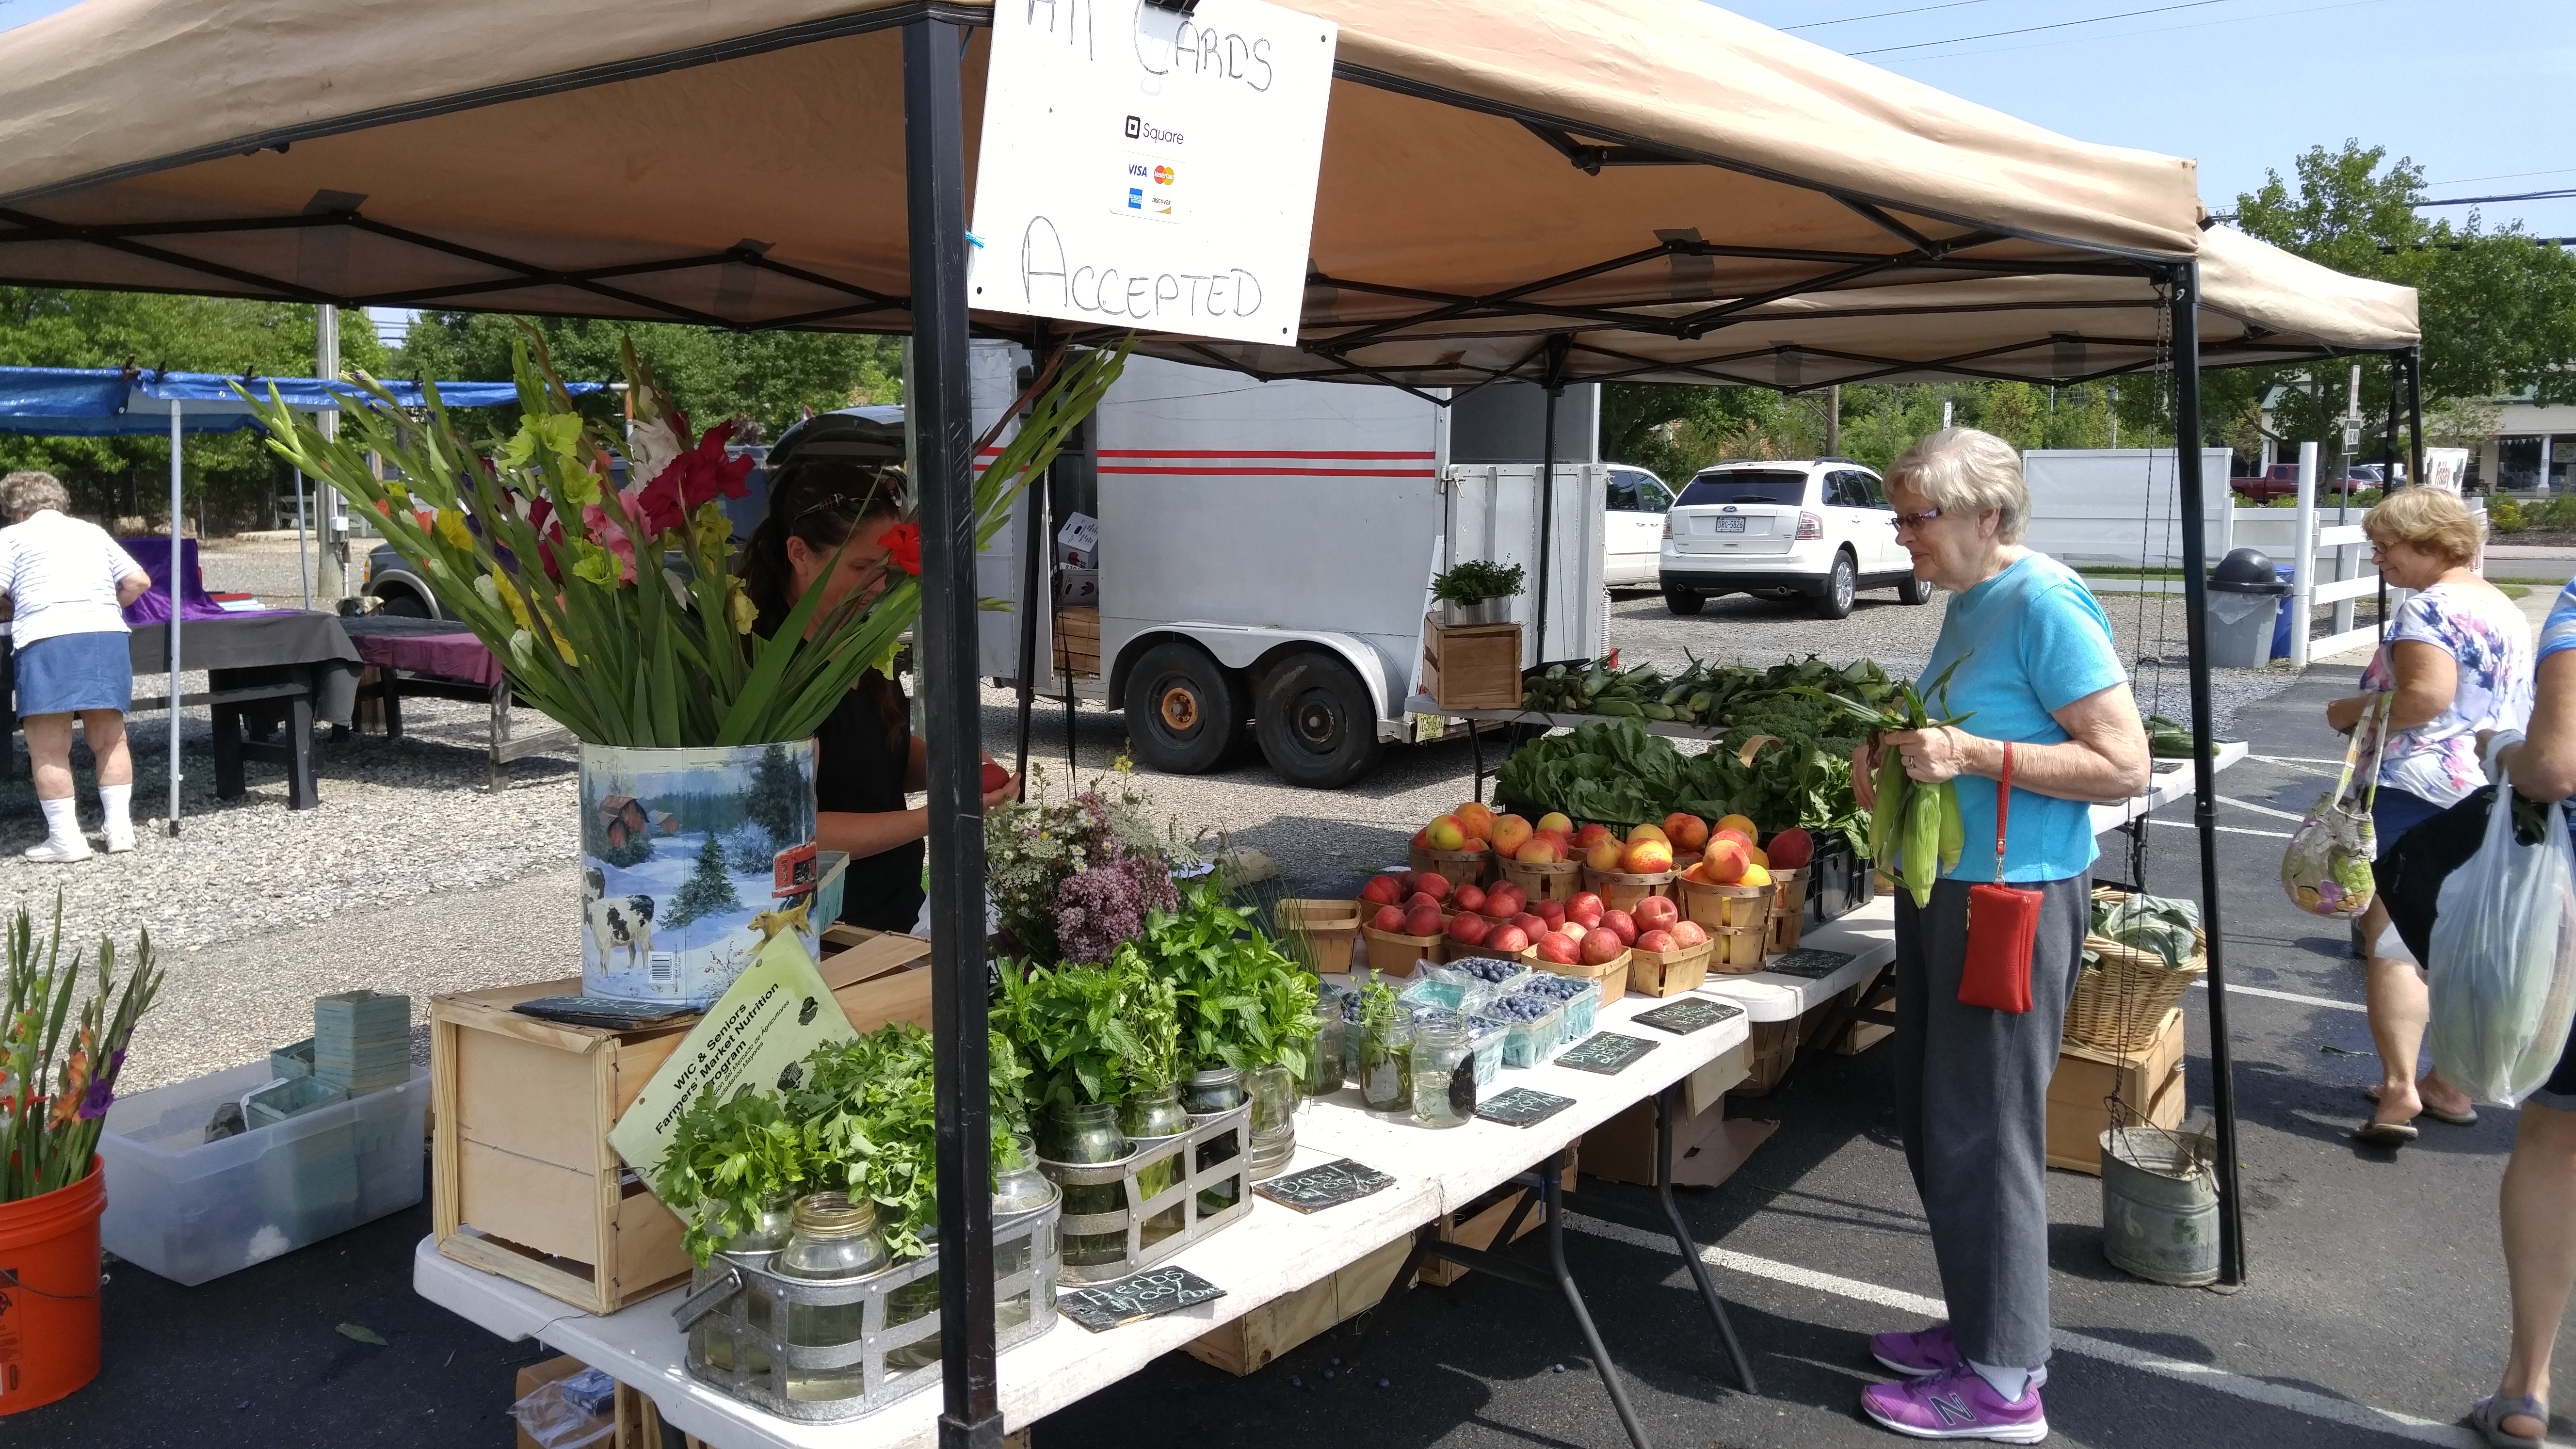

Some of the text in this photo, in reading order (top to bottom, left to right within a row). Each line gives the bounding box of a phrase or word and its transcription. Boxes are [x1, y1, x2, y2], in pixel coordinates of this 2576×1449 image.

[1143, 123, 1184, 145] Square
[1128, 163, 1147, 177] VISA
[1022, 215, 1262, 319] ACCEPTED
[2434, 461, 2451, 489] Friday
[1642, 1004, 1686, 1019] White
[700, 1035, 736, 1079] Market
[735, 983, 779, 1035] Nutrition
[673, 1003, 747, 1090] WIC & Seniors
[724, 1070, 733, 1081] del
[732, 1044, 754, 1072] Mercado
[754, 1034, 761, 1045] de
[742, 1041, 764, 1068] Mayores
[1266, 1164, 1347, 1194] Basil
[1078, 1270, 1185, 1306] Herbs
